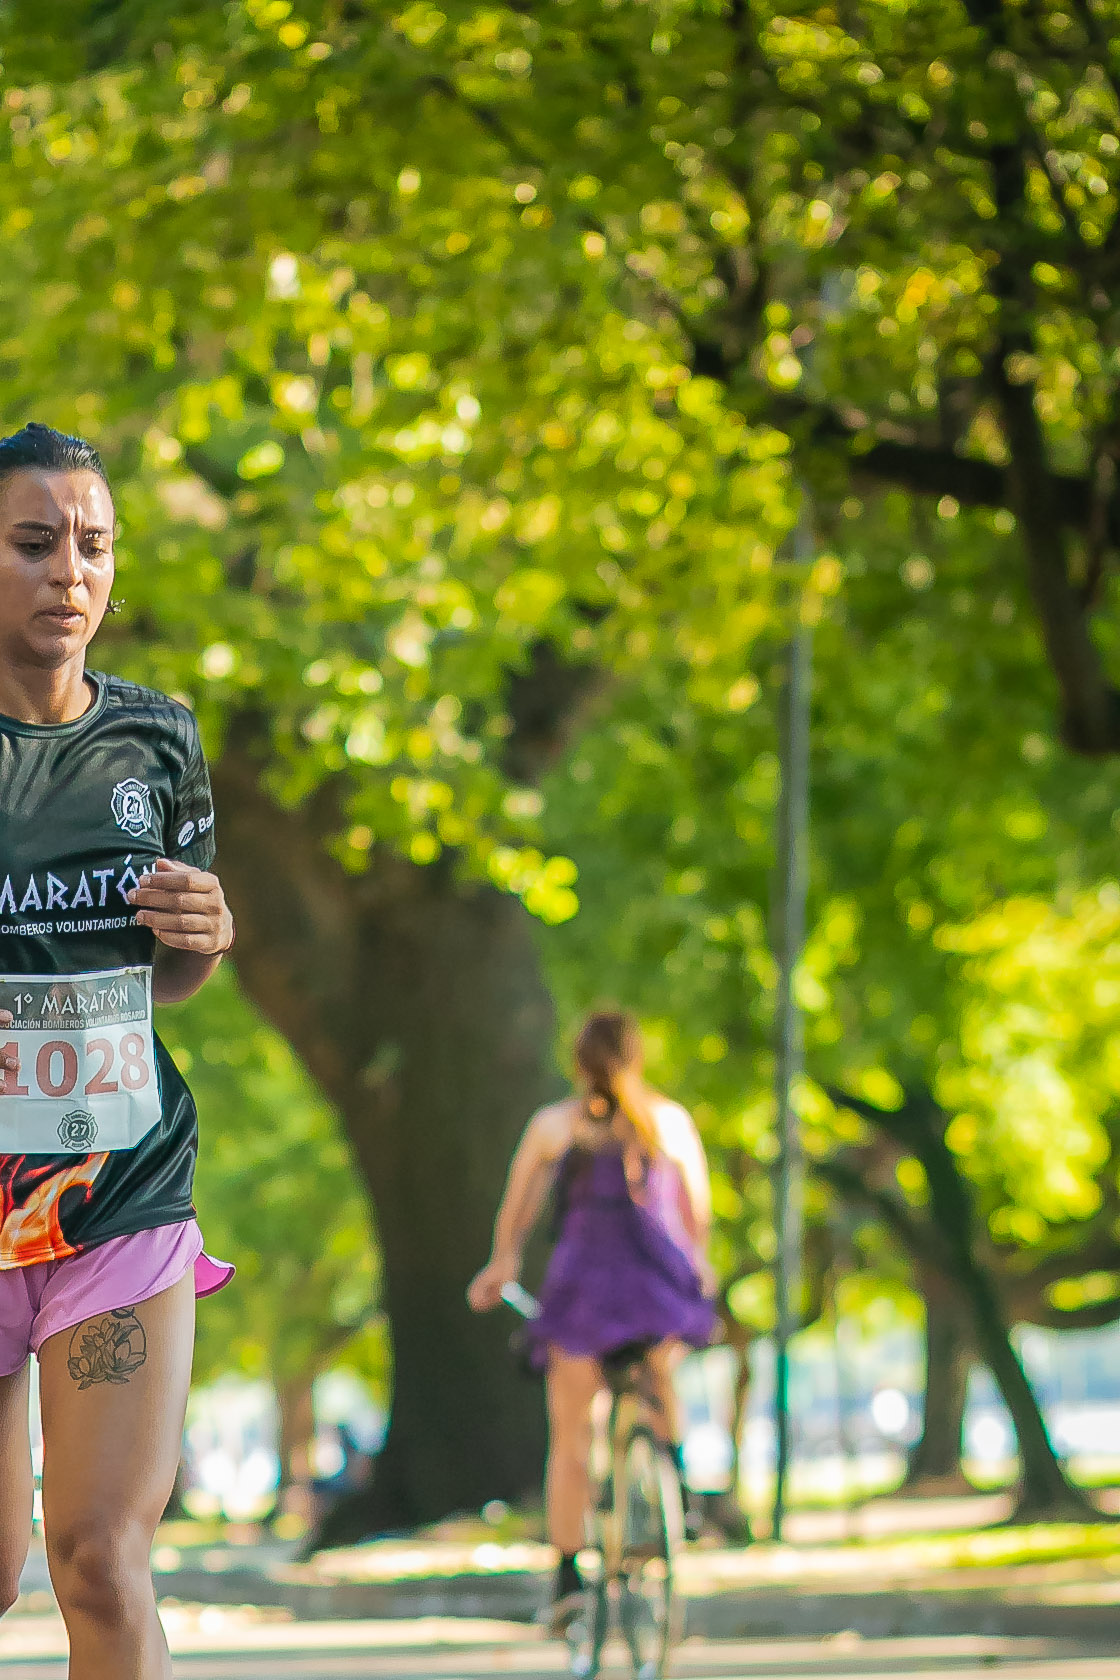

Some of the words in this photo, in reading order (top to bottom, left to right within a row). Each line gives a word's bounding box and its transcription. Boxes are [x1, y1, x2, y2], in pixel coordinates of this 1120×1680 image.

[56, 916, 127, 933] VOLUNTARIOS
[40, 981, 129, 1015] MARATÓN
[70, 1122, 88, 1137] 27
